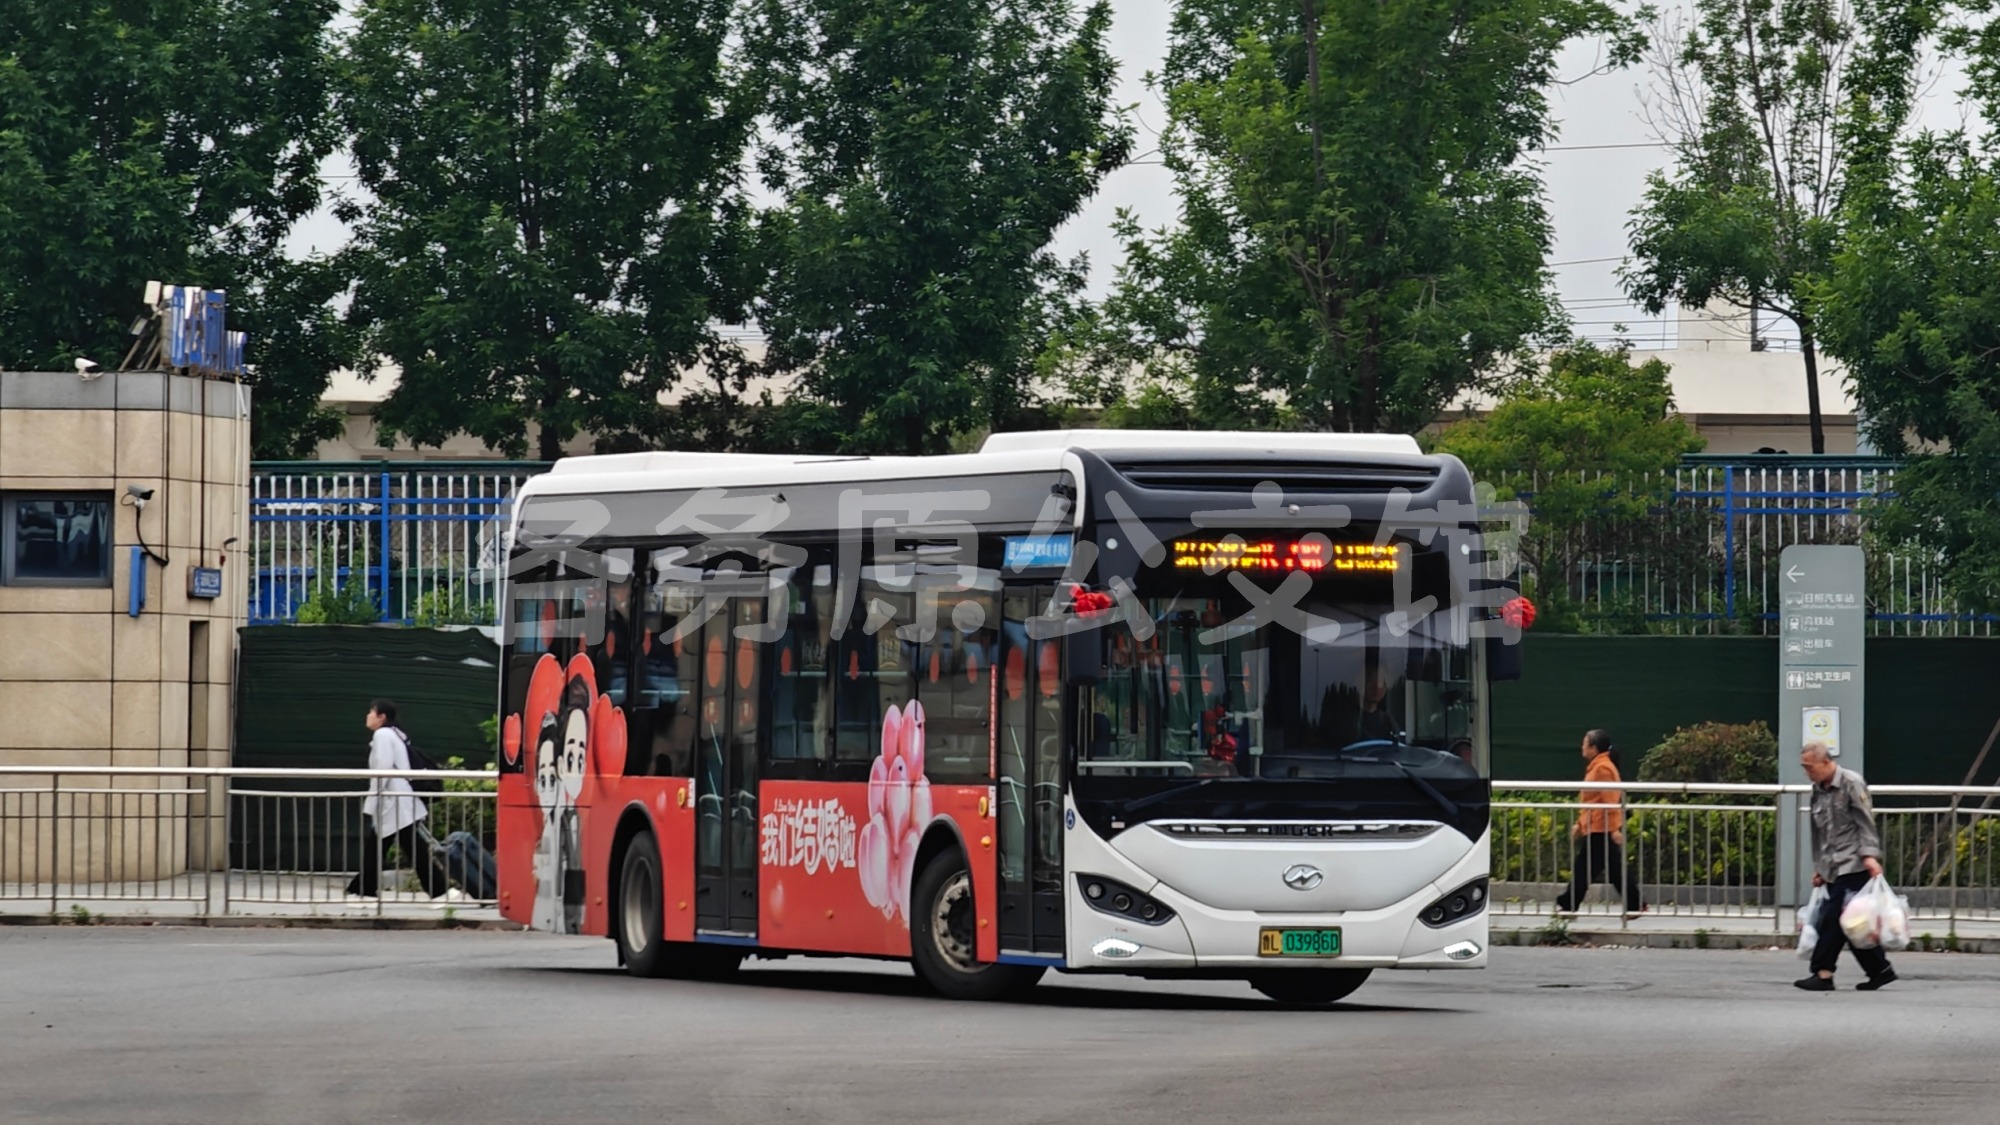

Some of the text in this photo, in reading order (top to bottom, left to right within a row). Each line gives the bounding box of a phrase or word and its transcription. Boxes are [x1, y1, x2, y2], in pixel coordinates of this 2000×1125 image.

[1804, 639, 1834, 649] 出租车
[1805, 671, 1851, 682] 公共卫生间
[762, 798, 857, 875] 我们结婚啦
